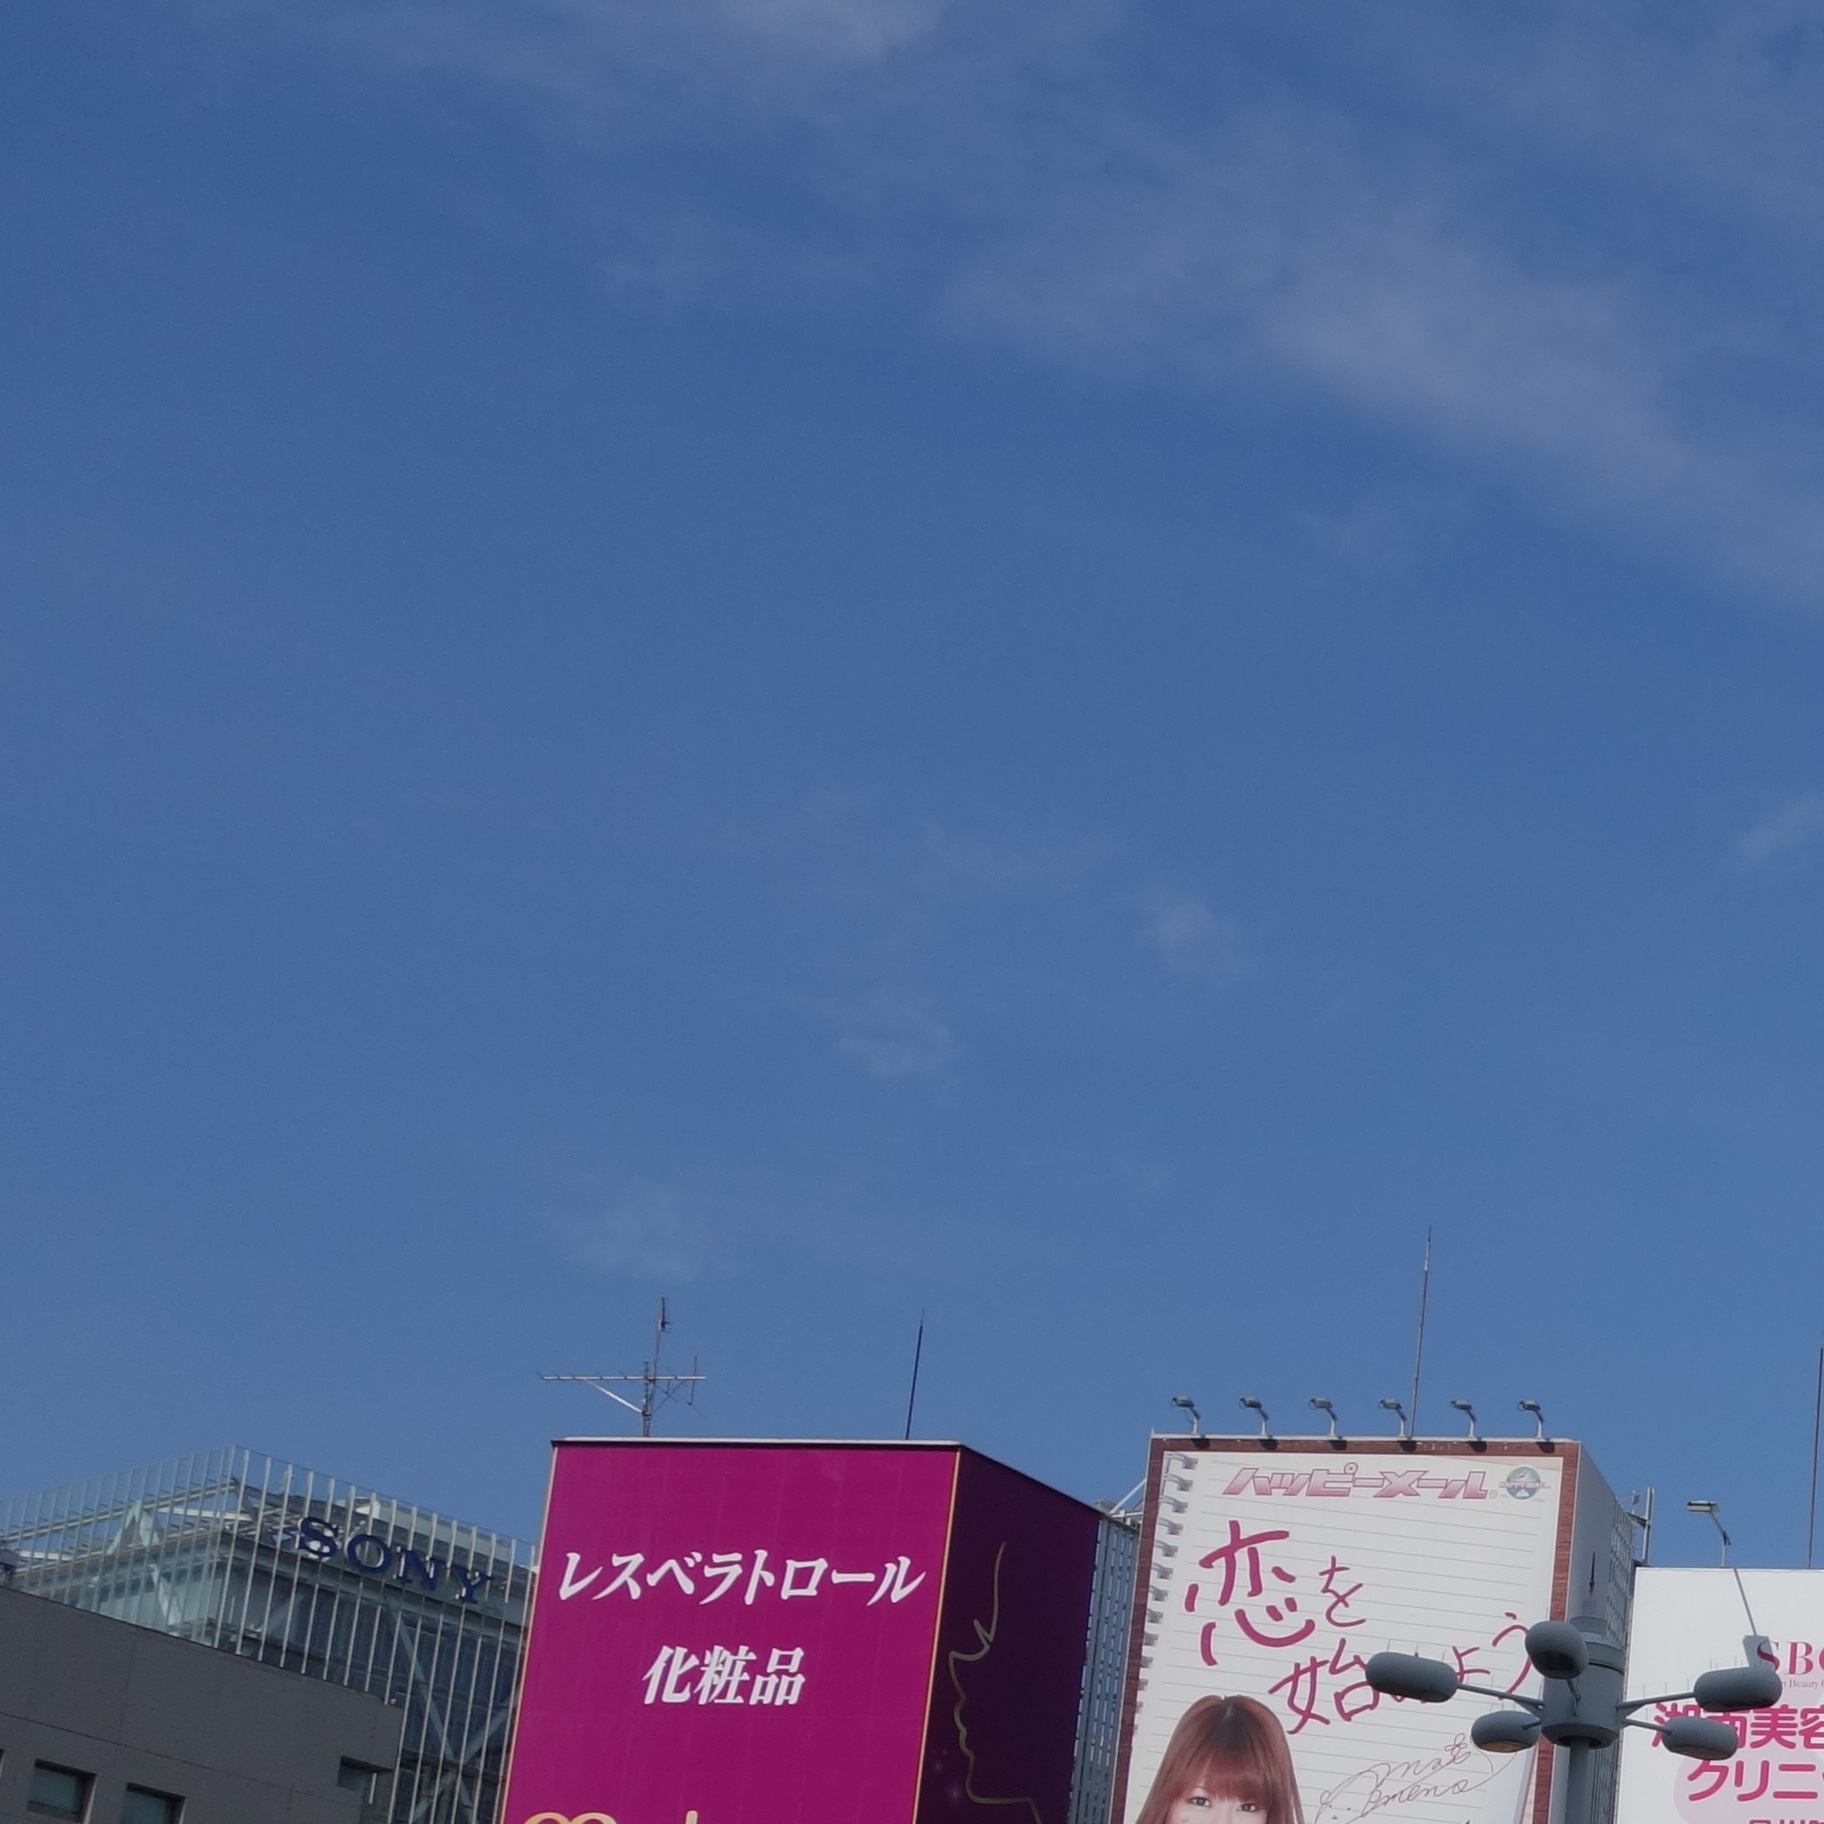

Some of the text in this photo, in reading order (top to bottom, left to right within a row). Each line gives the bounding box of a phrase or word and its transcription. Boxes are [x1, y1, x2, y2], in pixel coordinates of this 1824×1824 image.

[1222, 1463, 1488, 1500] ハッピーメール
[300, 1517, 492, 1603] SONY
[558, 1550, 924, 1606] レスベラトロール
[1185, 1520, 1366, 1666] 恋を
[643, 1644, 806, 1707] 化粧品
